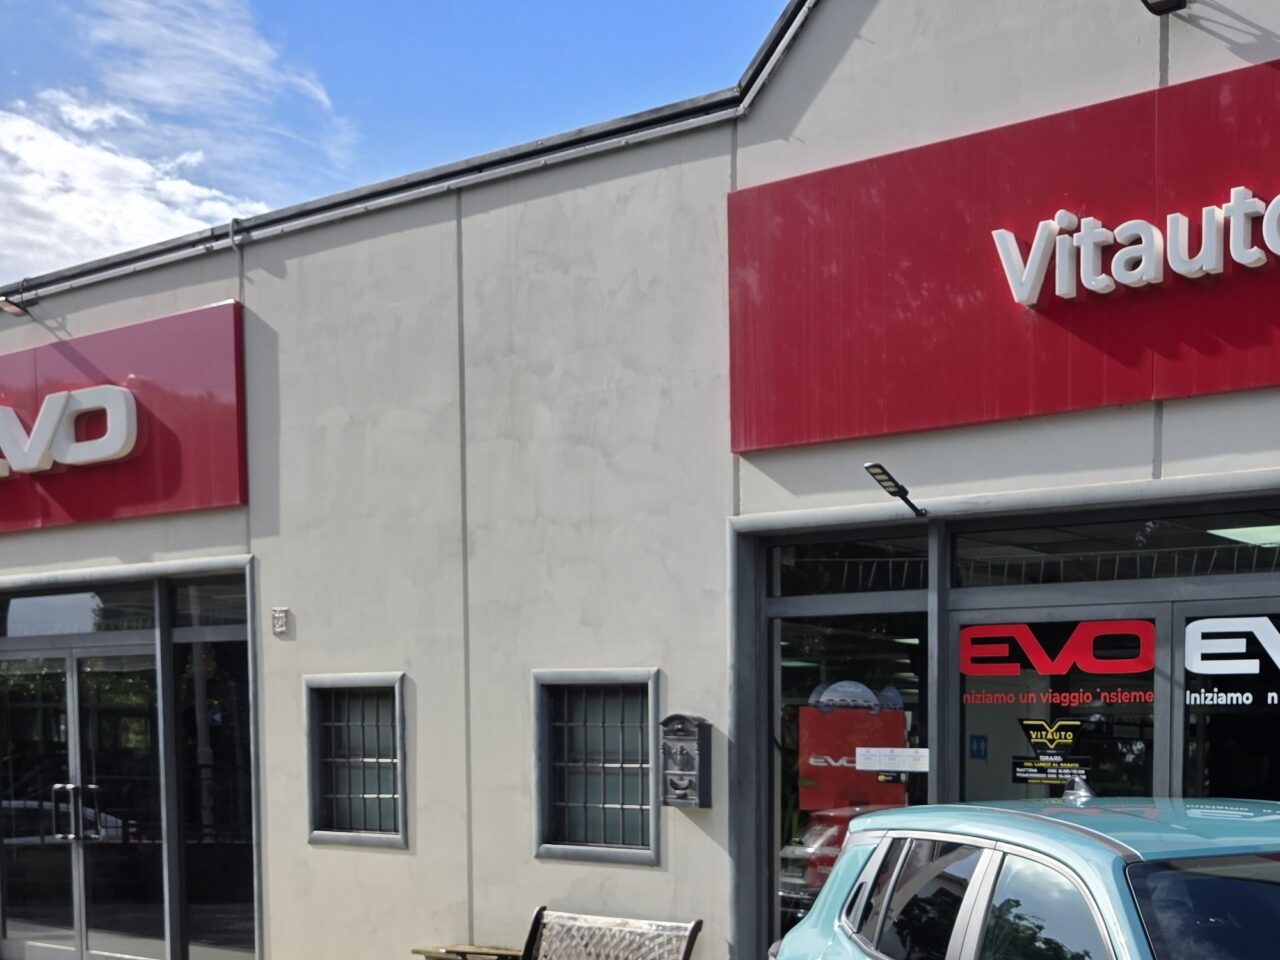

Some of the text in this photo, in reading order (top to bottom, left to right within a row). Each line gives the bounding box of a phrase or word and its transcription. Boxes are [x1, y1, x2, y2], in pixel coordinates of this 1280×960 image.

[0, 385, 137, 477] VO
[960, 619, 1156, 676] EVO
[1019, 691, 1037, 704] un
[1040, 688, 1092, 707] viaggio
[1096, 687, 1154, 704] nsieme
[1185, 687, 1253, 706] Iniziamo
[1030, 730, 1074, 740] VITAUTO
